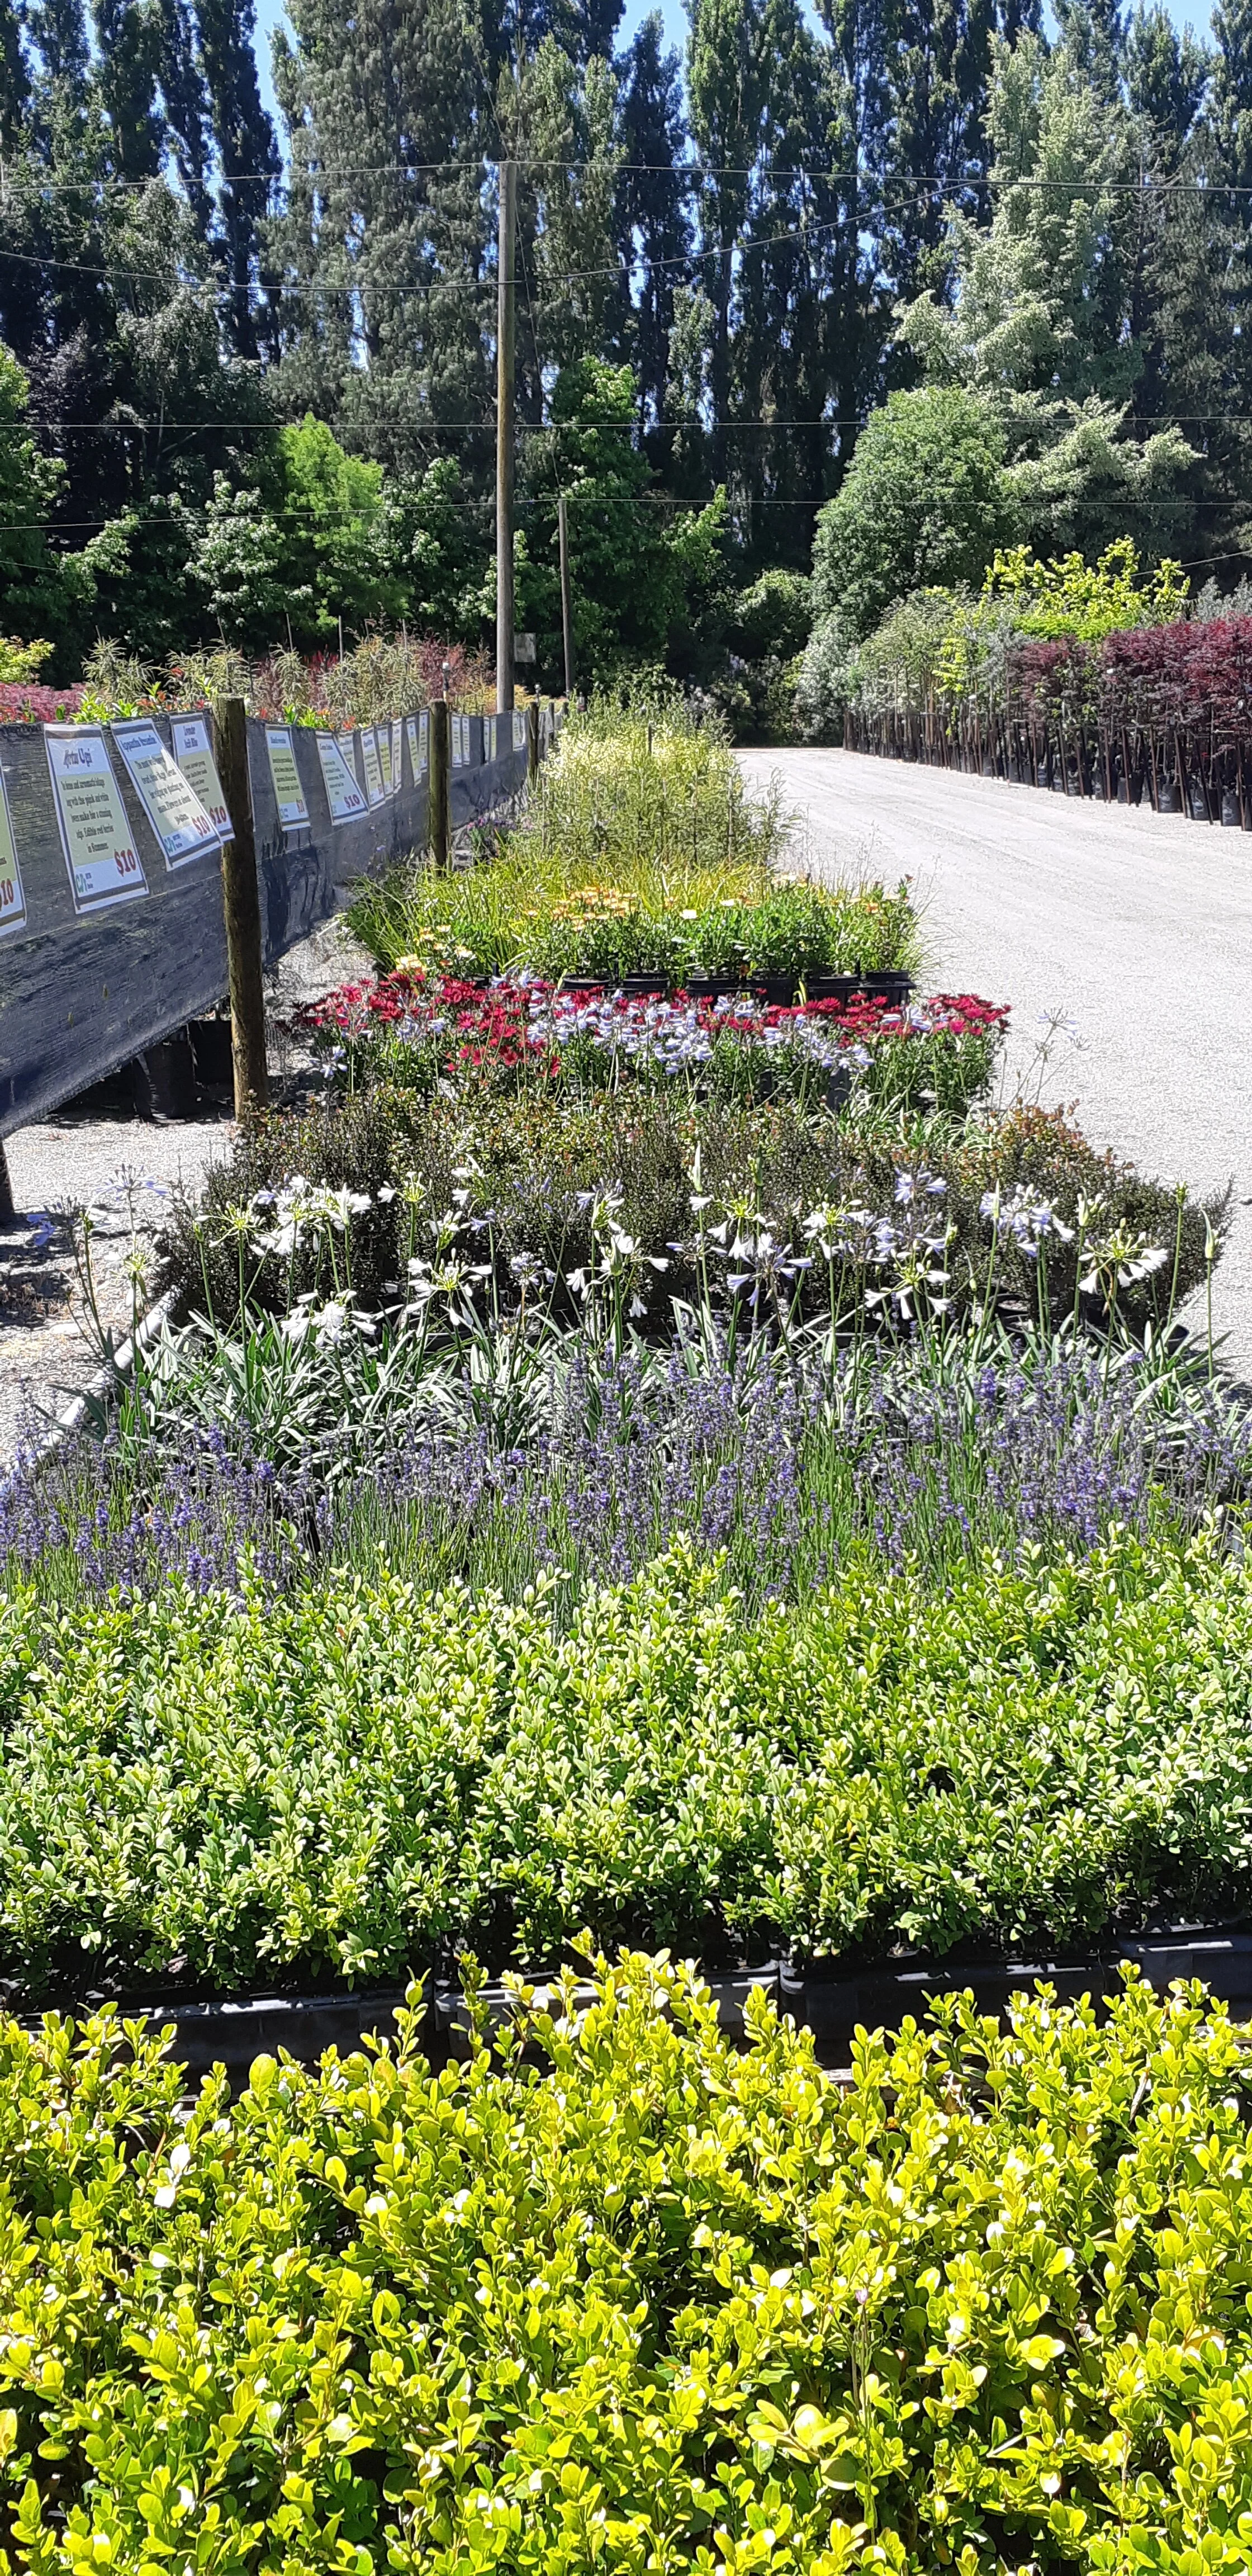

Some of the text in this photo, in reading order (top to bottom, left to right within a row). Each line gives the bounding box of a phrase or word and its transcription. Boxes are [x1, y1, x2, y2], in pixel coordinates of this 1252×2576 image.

[344, 794, 361, 809] $10
[191, 815, 211, 838] $10
[209, 805, 227, 826] $10
[114, 848, 136, 877] $10
[0, 878, 13, 911] 10
